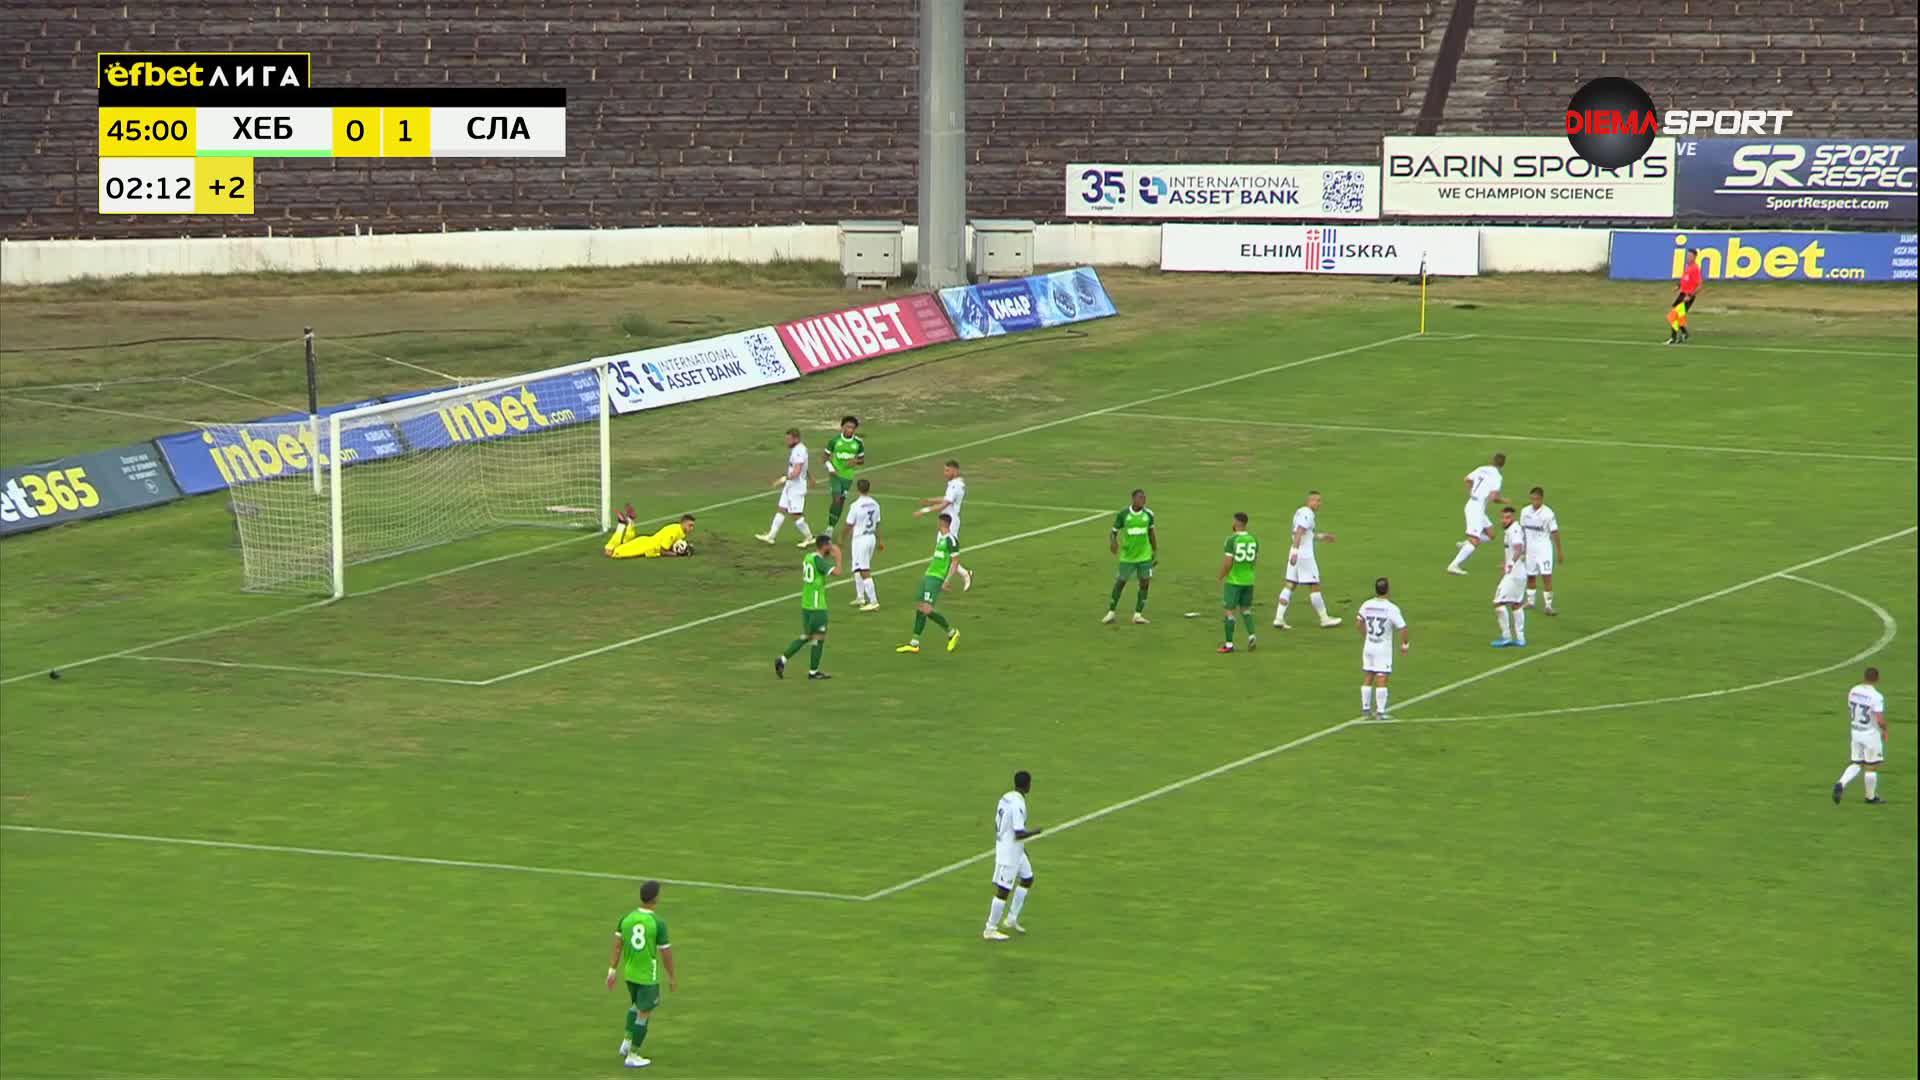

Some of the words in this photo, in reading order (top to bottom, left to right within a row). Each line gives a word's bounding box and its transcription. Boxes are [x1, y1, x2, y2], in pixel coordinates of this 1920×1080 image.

[1390, 155, 1502, 178] BARIN
[1724, 145, 1807, 187] SR
[1812, 145, 1904, 166] SPORT
[1169, 176, 1300, 189] INTERNATIONAL
[1807, 166, 1918, 188] RESPEC
[1169, 190, 1234, 204] ASSET
[1240, 190, 1299, 204] BANK
[1438, 188, 1461, 199] WE
[1465, 188, 1545, 199] CHAMPION
[1550, 188, 1614, 200] SCIENCE
[1766, 196, 1889, 210] SportRespect.com
[1240, 243, 1302, 257] ELHIM
[1339, 244, 1397, 258] ISKRA
[1671, 234, 1865, 280] inbet.com
[987, 295, 1031, 320] ХИСАР
[786, 302, 913, 368] WINBET
[658, 348, 738, 372] INTERNATIONAL
[666, 368, 705, 390] ASSET
[706, 360, 747, 381] BANK
[203, 424, 359, 483] inbetom
[865, 510, 876, 529] 3
[1235, 543, 1257, 562] 55
[1366, 615, 1387, 637] 33
[631, 924, 646, 950] 8
